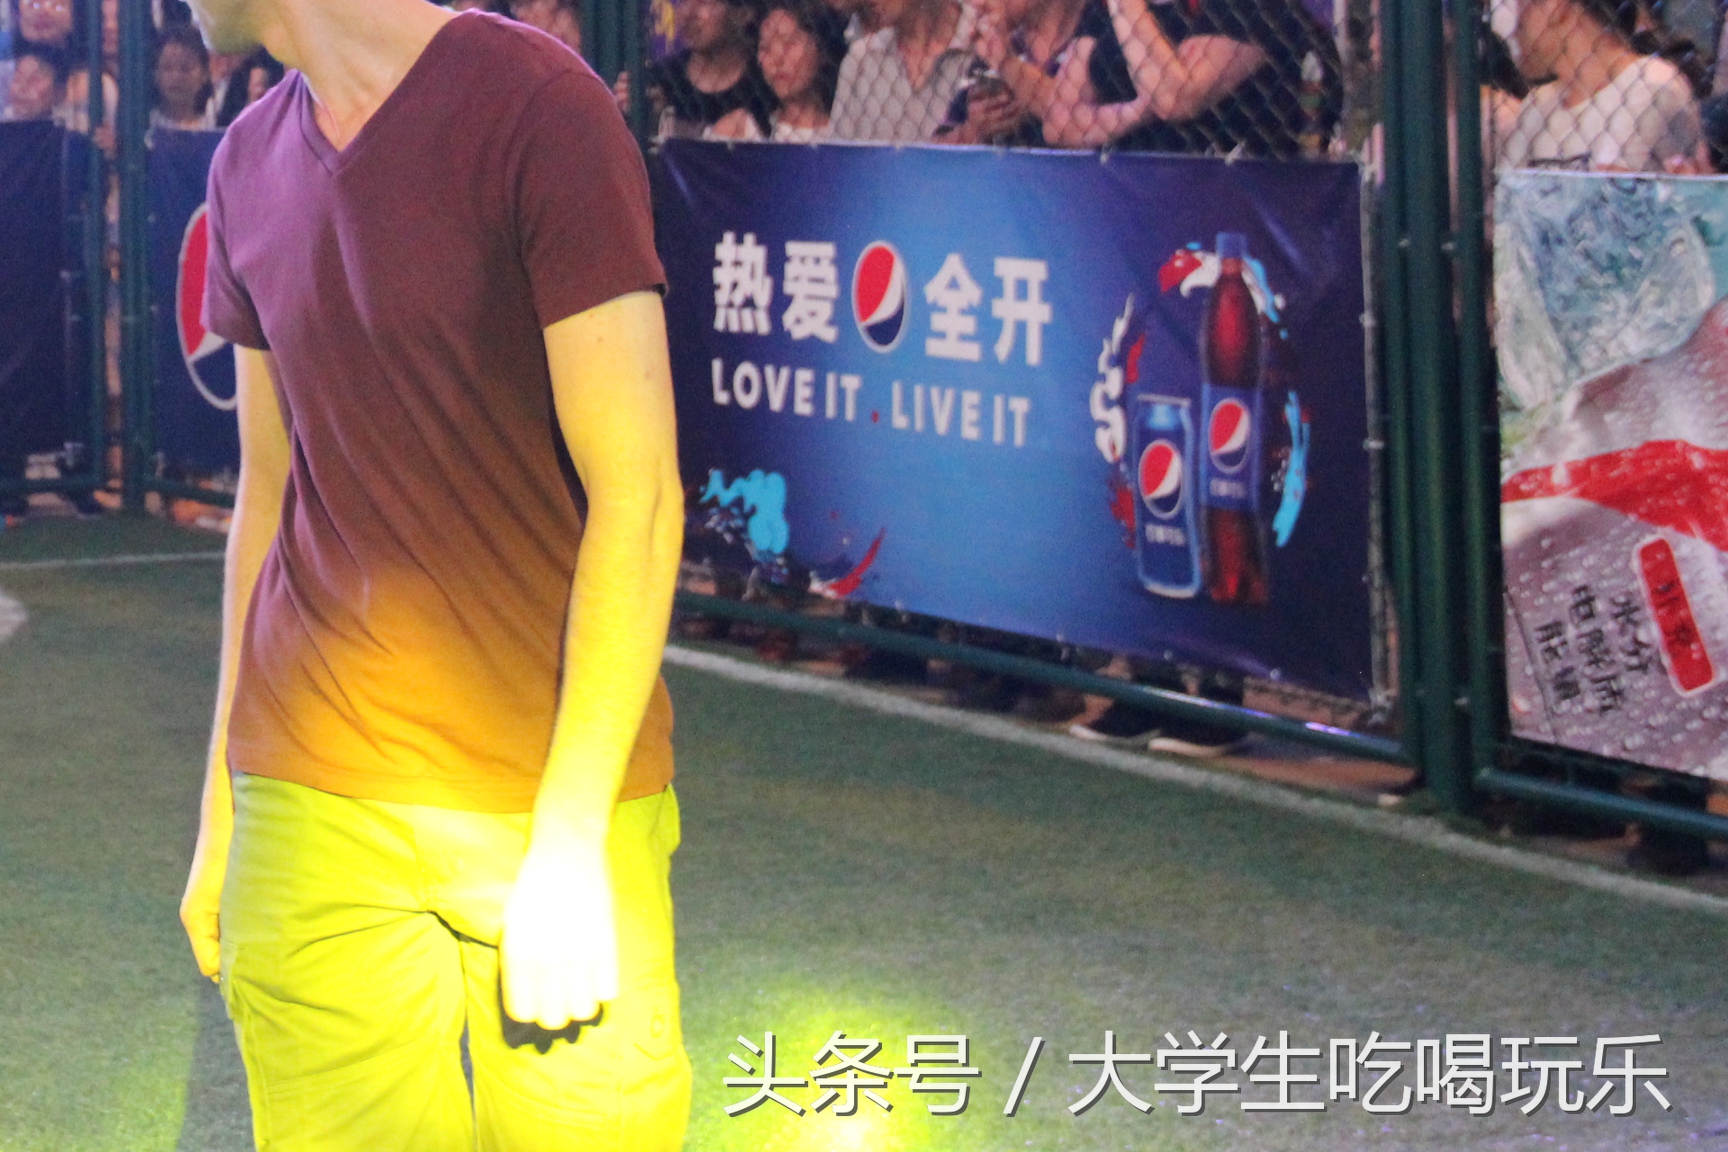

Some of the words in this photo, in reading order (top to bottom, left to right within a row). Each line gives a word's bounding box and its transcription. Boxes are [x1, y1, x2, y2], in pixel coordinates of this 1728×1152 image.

[712, 230, 840, 344] 热爱
[923, 253, 1054, 367] 全开
[711, 357, 816, 417] LOVE
[891, 380, 983, 441] LIVE
[992, 395, 1031, 447] IT
